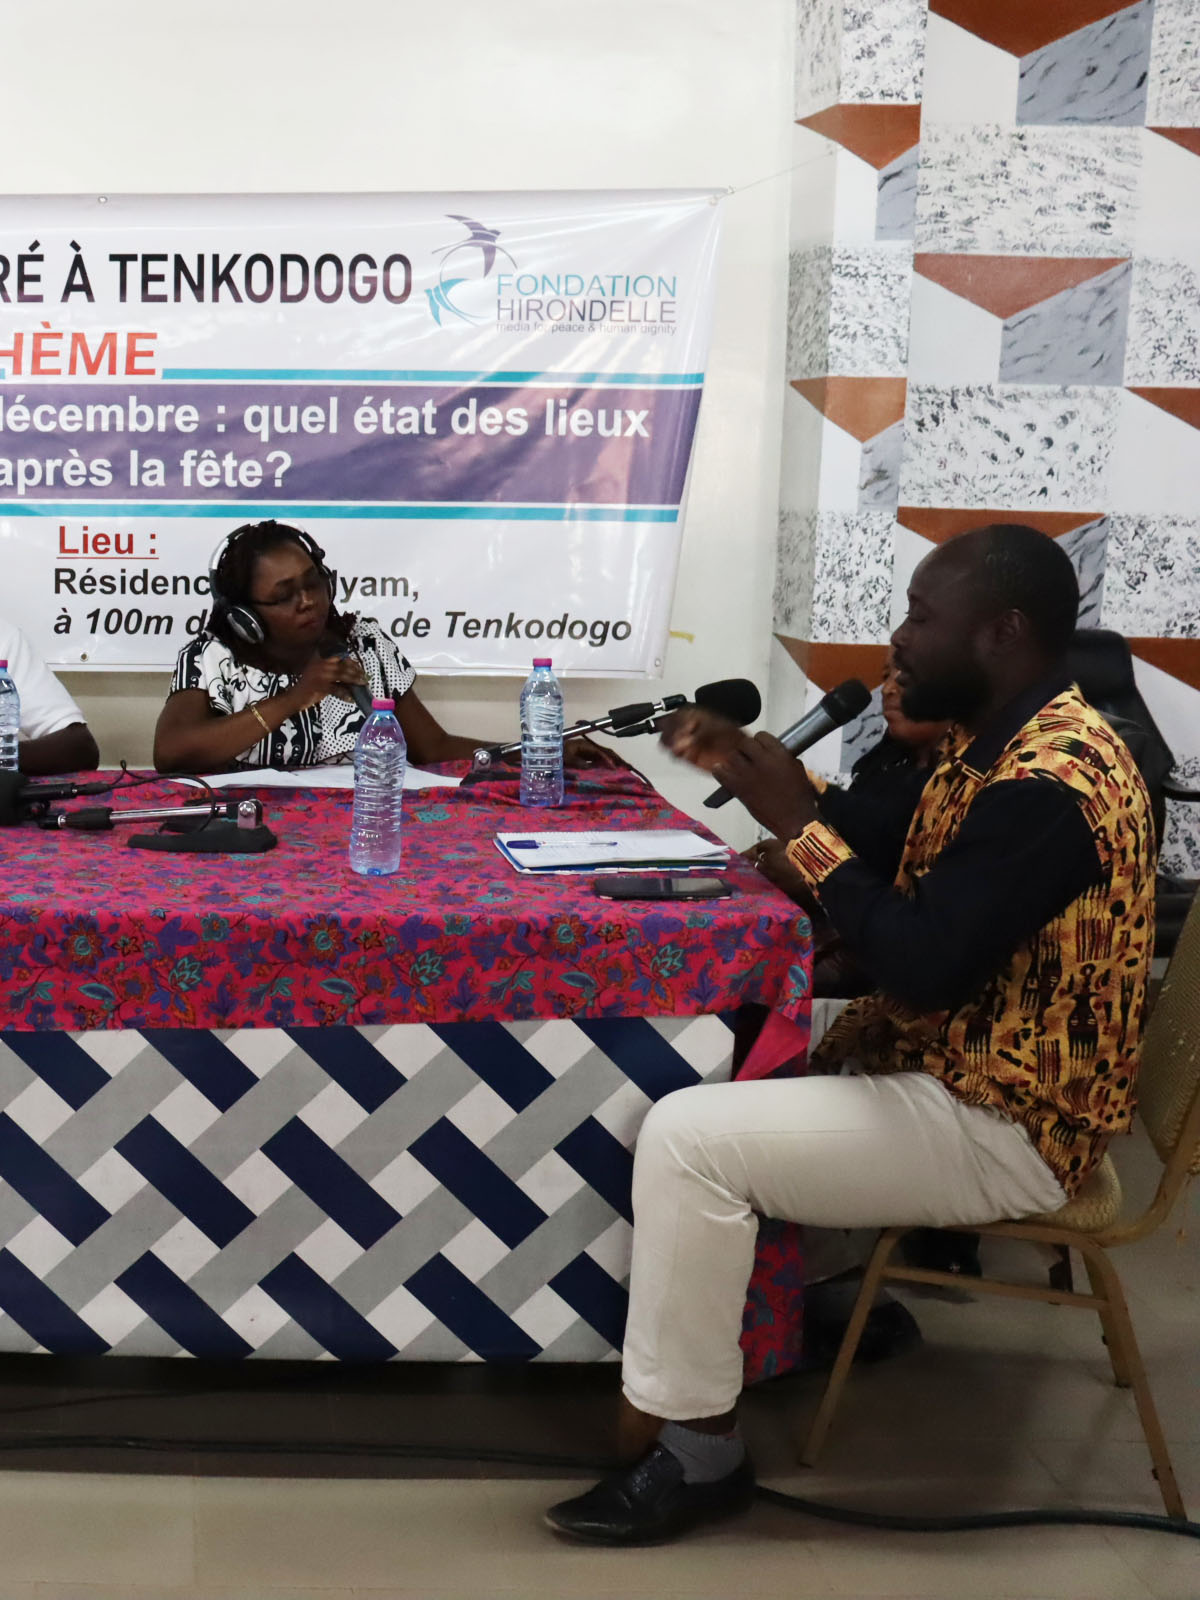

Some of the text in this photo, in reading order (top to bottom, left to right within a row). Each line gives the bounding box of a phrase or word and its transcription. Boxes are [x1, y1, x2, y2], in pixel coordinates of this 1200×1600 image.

[60, 240, 95, 302] À
[109, 253, 412, 304] TENKODOGO
[497, 274, 677, 297] FONDATION
[497, 298, 677, 323] HIRONDELLE
[552, 322, 585, 334] peace
[588, 322, 596, 333] &
[640, 323, 677, 336] dignity
[217, 406, 225, 432] :
[243, 397, 338, 442] quel
[353, 396, 437, 434] état
[451, 398, 529, 435] des
[545, 398, 650, 437] lieux
[130, 449, 166, 487] la
[180, 449, 292, 487] fête?
[59, 526, 134, 554] Lieu
[54, 568, 211, 595] Résidenc
[54, 607, 72, 634] à
[86, 608, 173, 635] 100m
[390, 611, 431, 638] de
[445, 611, 632, 648] Tenkodogo
